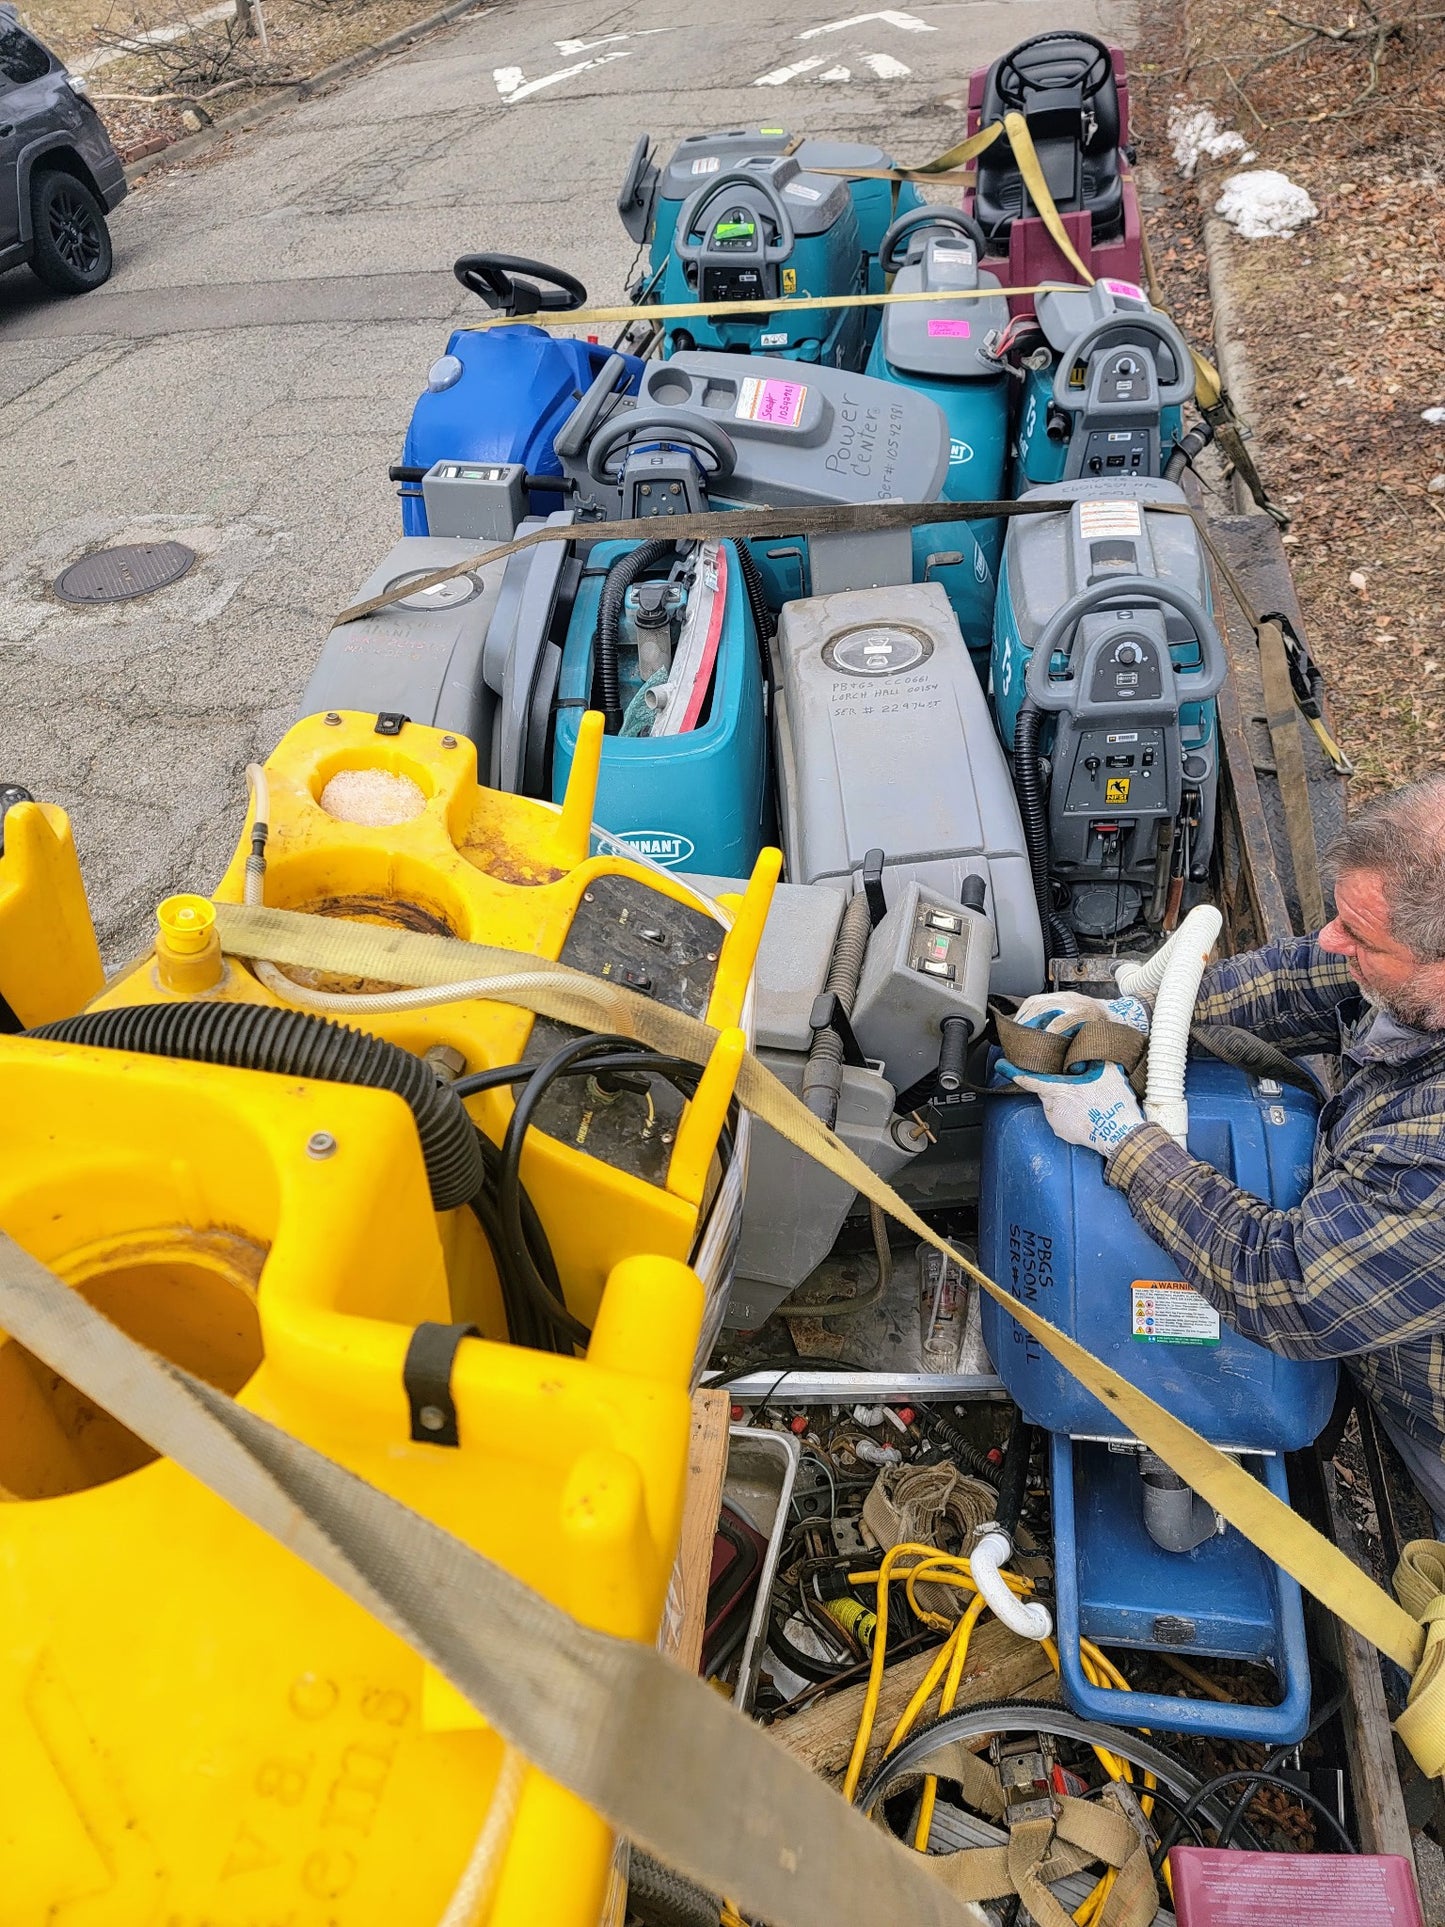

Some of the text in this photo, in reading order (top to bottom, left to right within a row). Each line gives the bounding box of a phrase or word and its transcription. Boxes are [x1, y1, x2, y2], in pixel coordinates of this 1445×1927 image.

[825, 392, 859, 475] Power
[850, 408, 878, 477] Center
[833, 707, 857, 716] SER
[874, 689, 899, 698] HALL
[575, 1110, 594, 1144] CHEMICAL
[1009, 1223, 1021, 1263] SER
[1022, 1229, 1038, 1302] MASON
[1037, 1235, 1054, 1289] PBGS
